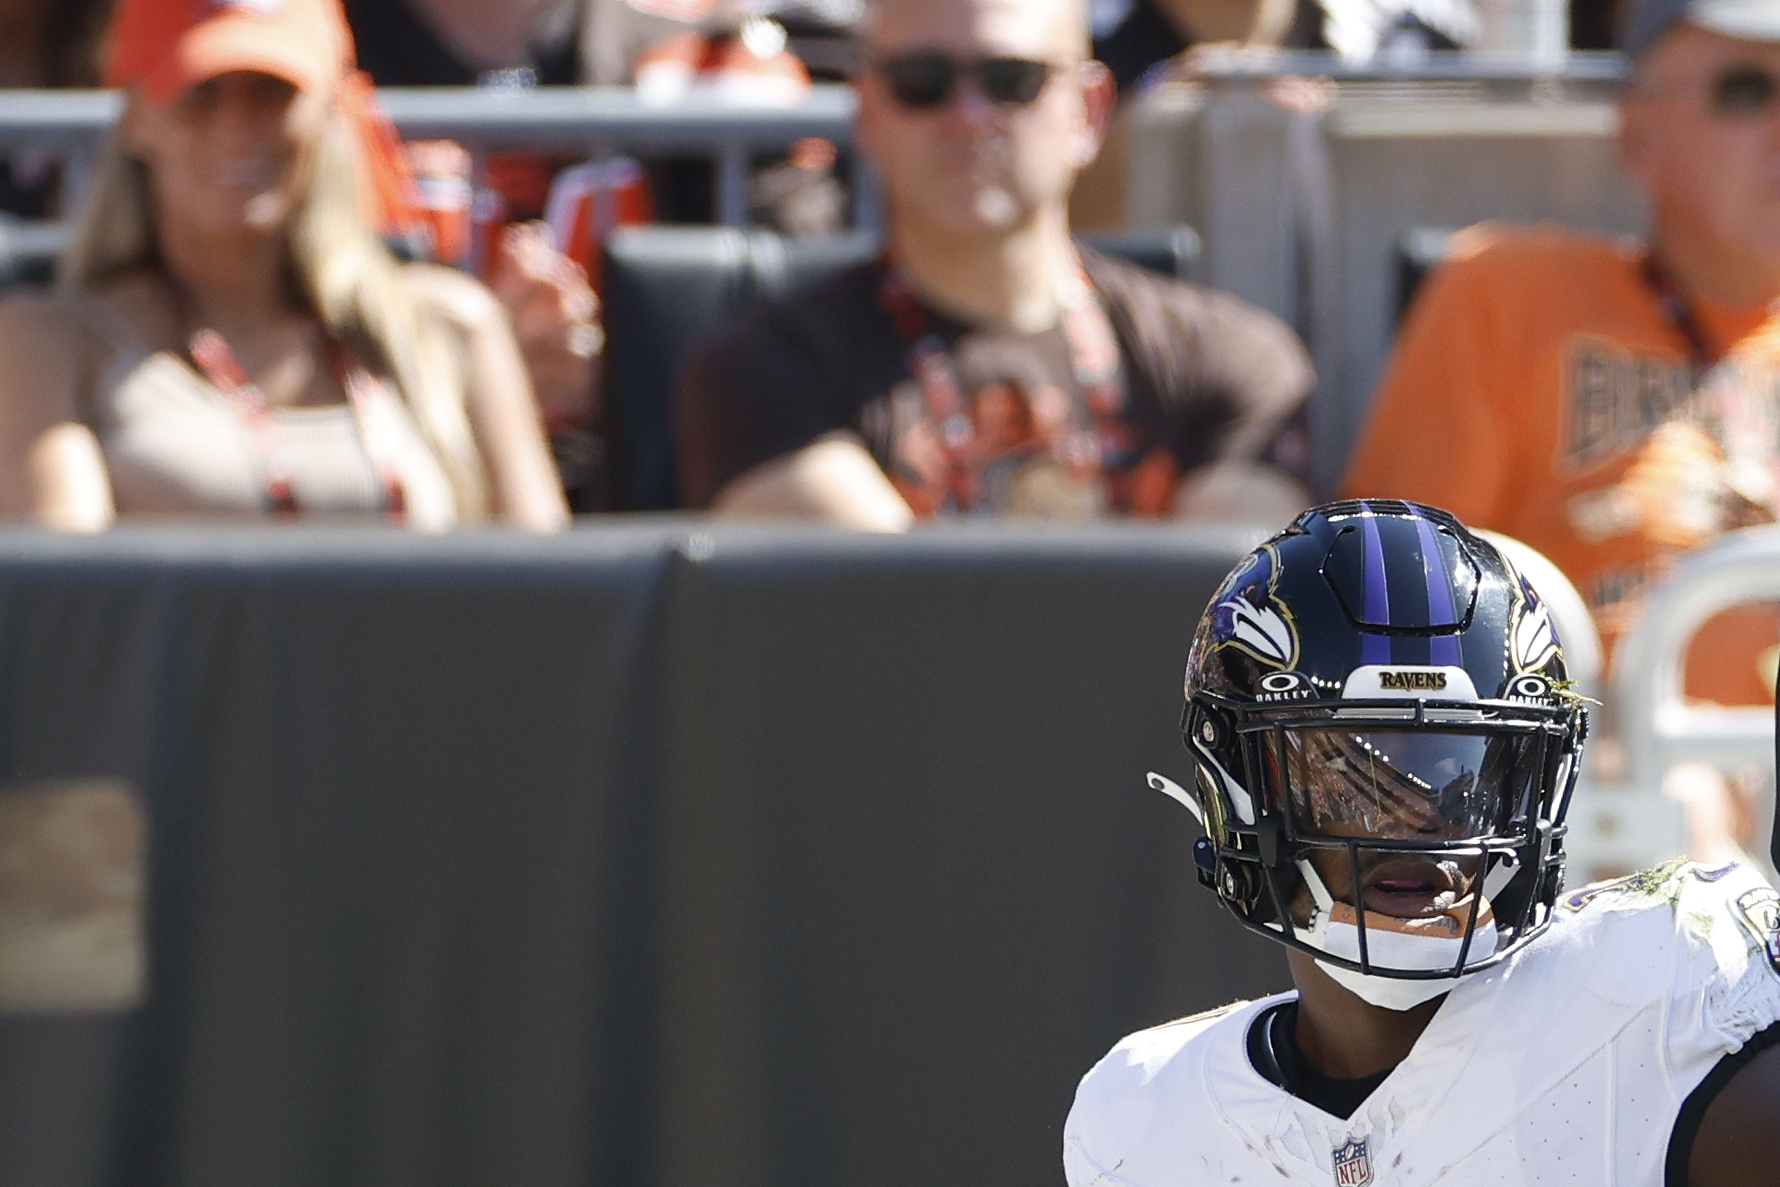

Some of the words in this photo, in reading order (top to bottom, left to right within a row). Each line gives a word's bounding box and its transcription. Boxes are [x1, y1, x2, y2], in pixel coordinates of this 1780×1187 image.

[1378, 671, 1447, 691] RAVENS
[1256, 690, 1309, 703] OAKLEY
[1338, 1158, 1367, 1185] NFL
